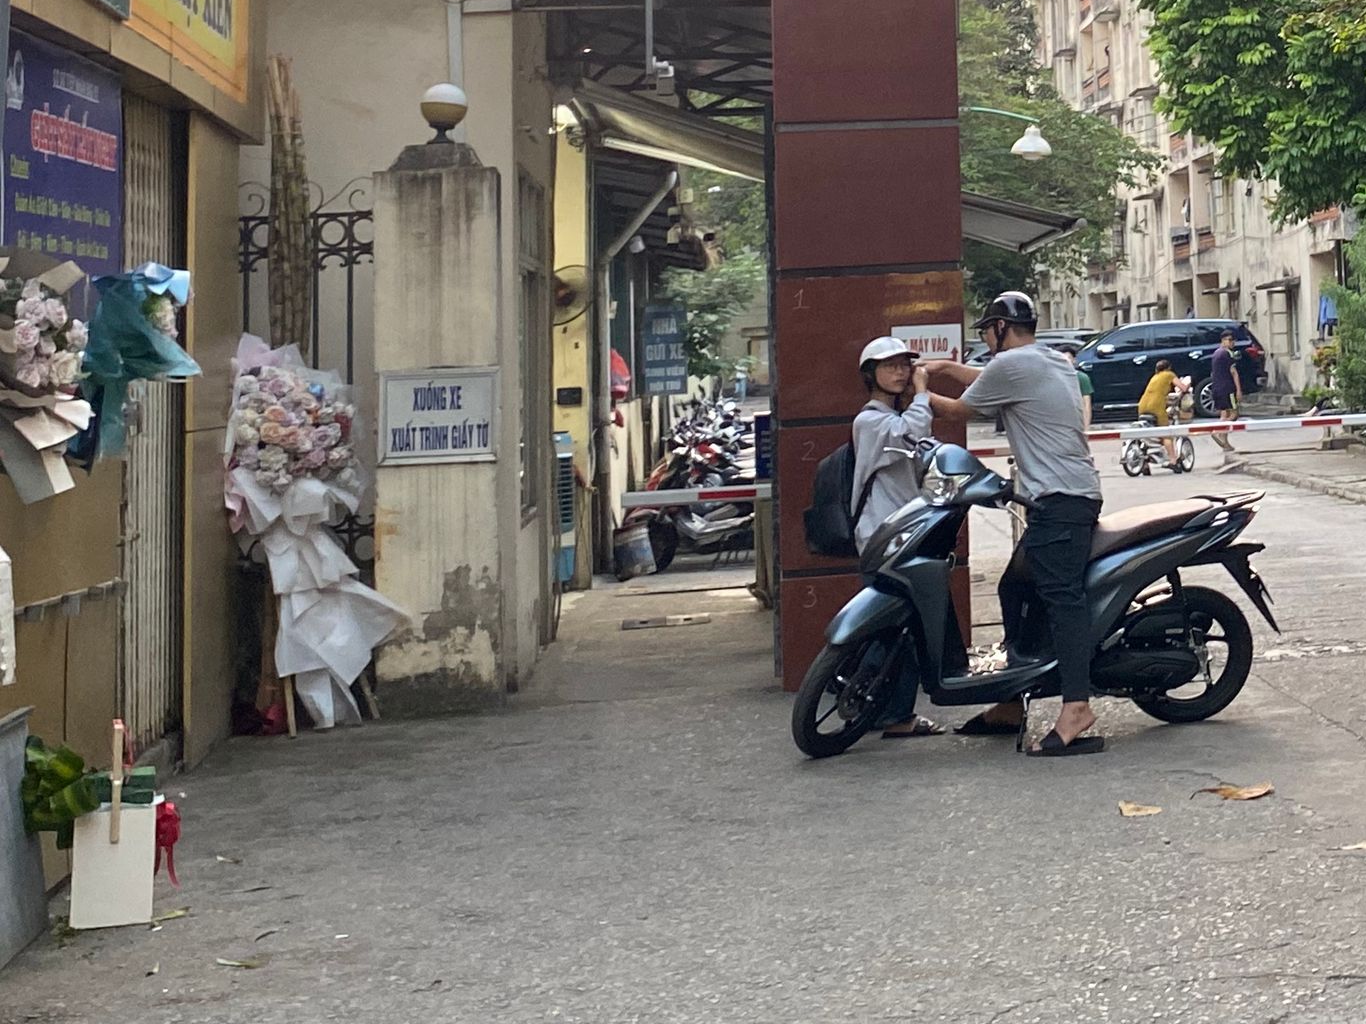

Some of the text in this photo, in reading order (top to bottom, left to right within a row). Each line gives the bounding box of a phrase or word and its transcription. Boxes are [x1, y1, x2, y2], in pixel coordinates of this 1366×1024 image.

[793, 288, 810, 310] 1
[910, 334, 929, 353] MÁY
[932, 333, 948, 352] VÀO
[413, 381, 461, 411] XUỐNG XE
[391, 420, 416, 452] XUẤT
[420, 421, 449, 451] TRÌNH
[451, 418, 474, 449] GIẤY
[801, 440, 817, 461] 2
[803, 585, 817, 608] 3
